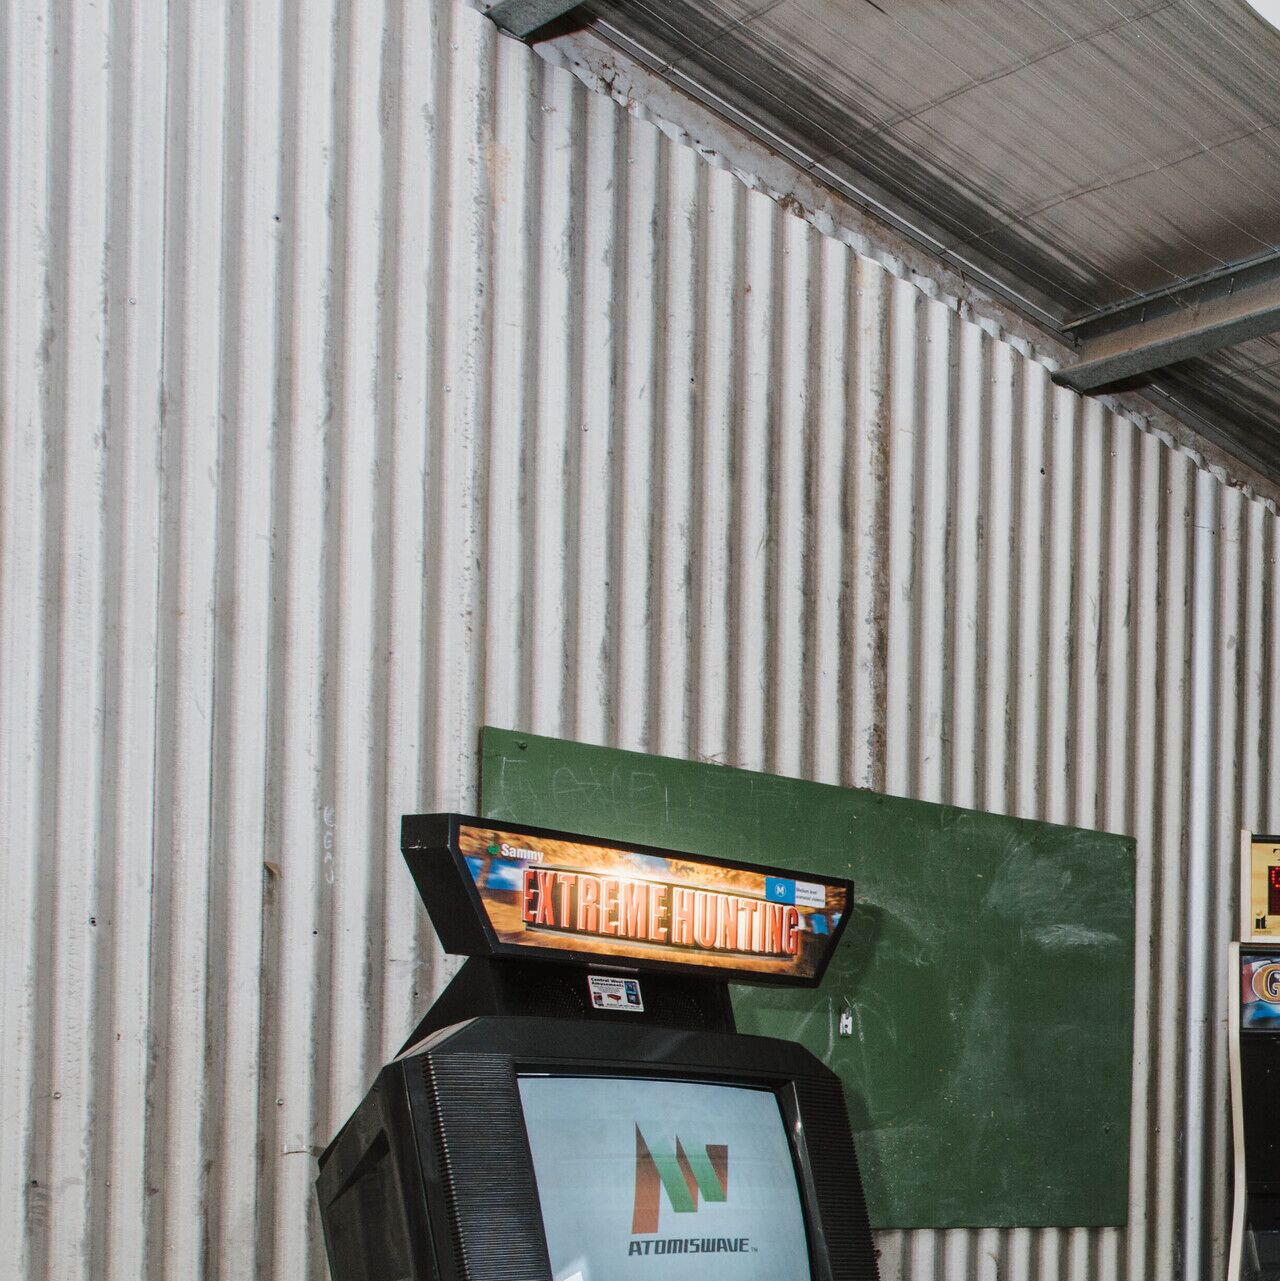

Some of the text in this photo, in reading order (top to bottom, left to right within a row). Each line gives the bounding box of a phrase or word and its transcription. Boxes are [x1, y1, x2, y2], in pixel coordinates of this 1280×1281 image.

[501, 843, 544, 864] Sammy
[522, 870, 799, 955] EXTREME HUNTING
[628, 1238, 749, 1256] ATOMISWAVE
